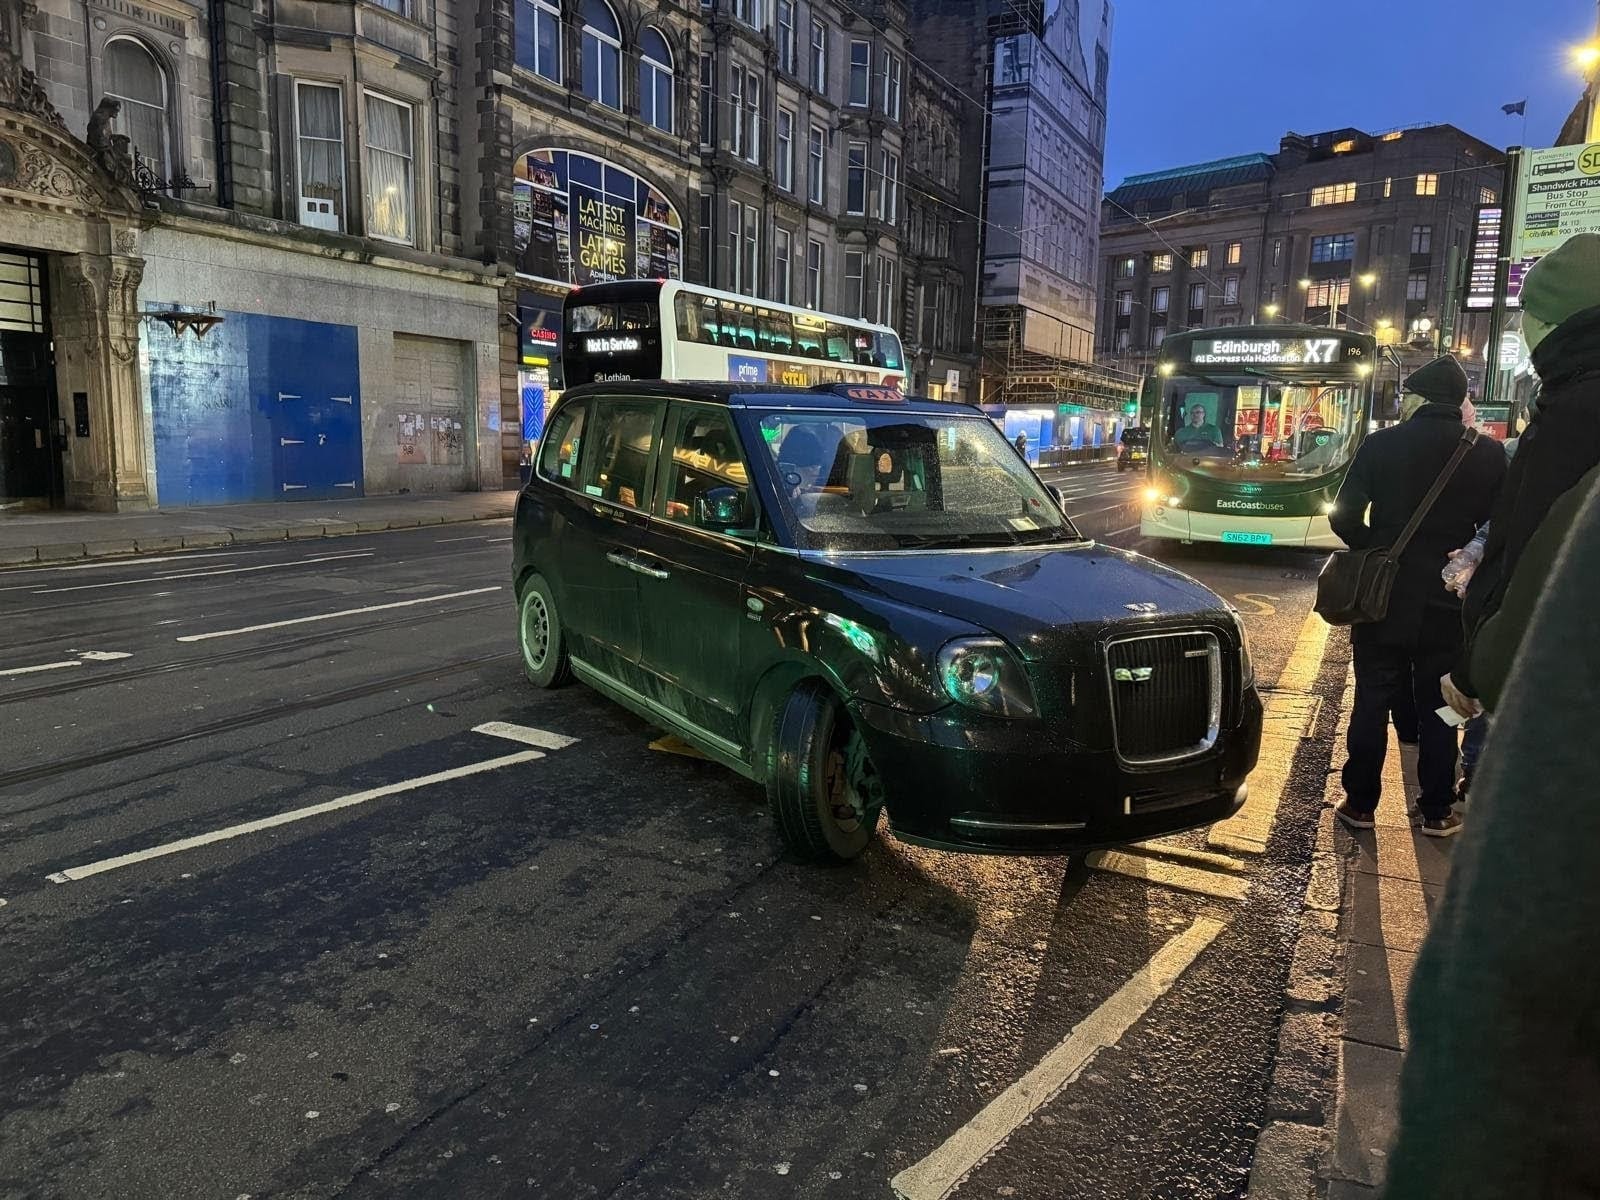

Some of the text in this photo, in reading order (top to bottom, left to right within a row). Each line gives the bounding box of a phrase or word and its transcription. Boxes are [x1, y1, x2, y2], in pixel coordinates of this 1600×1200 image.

[1531, 181, 1578, 192] Shandwick
[1547, 189, 1588, 200] Bus Stop
[579, 195, 625, 223] LATEST
[1545, 199, 1587, 210] From City
[579, 214, 626, 237] MACHINES
[579, 231, 626, 258] LATEST
[580, 250, 626, 275] GAMES
[587, 339, 601, 352] Not
[610, 337, 637, 351] Service
[1213, 339, 1338, 363] Edinburgh X7
[1347, 347, 1361, 356] 196
[1206, 354, 1240, 363] Express
[1241, 354, 1254, 363] via
[738, 363, 758, 376] prime
[604, 372, 630, 382] Lothian
[851, 390, 902, 400] TAXI
[1226, 533, 1248, 542] SN62
